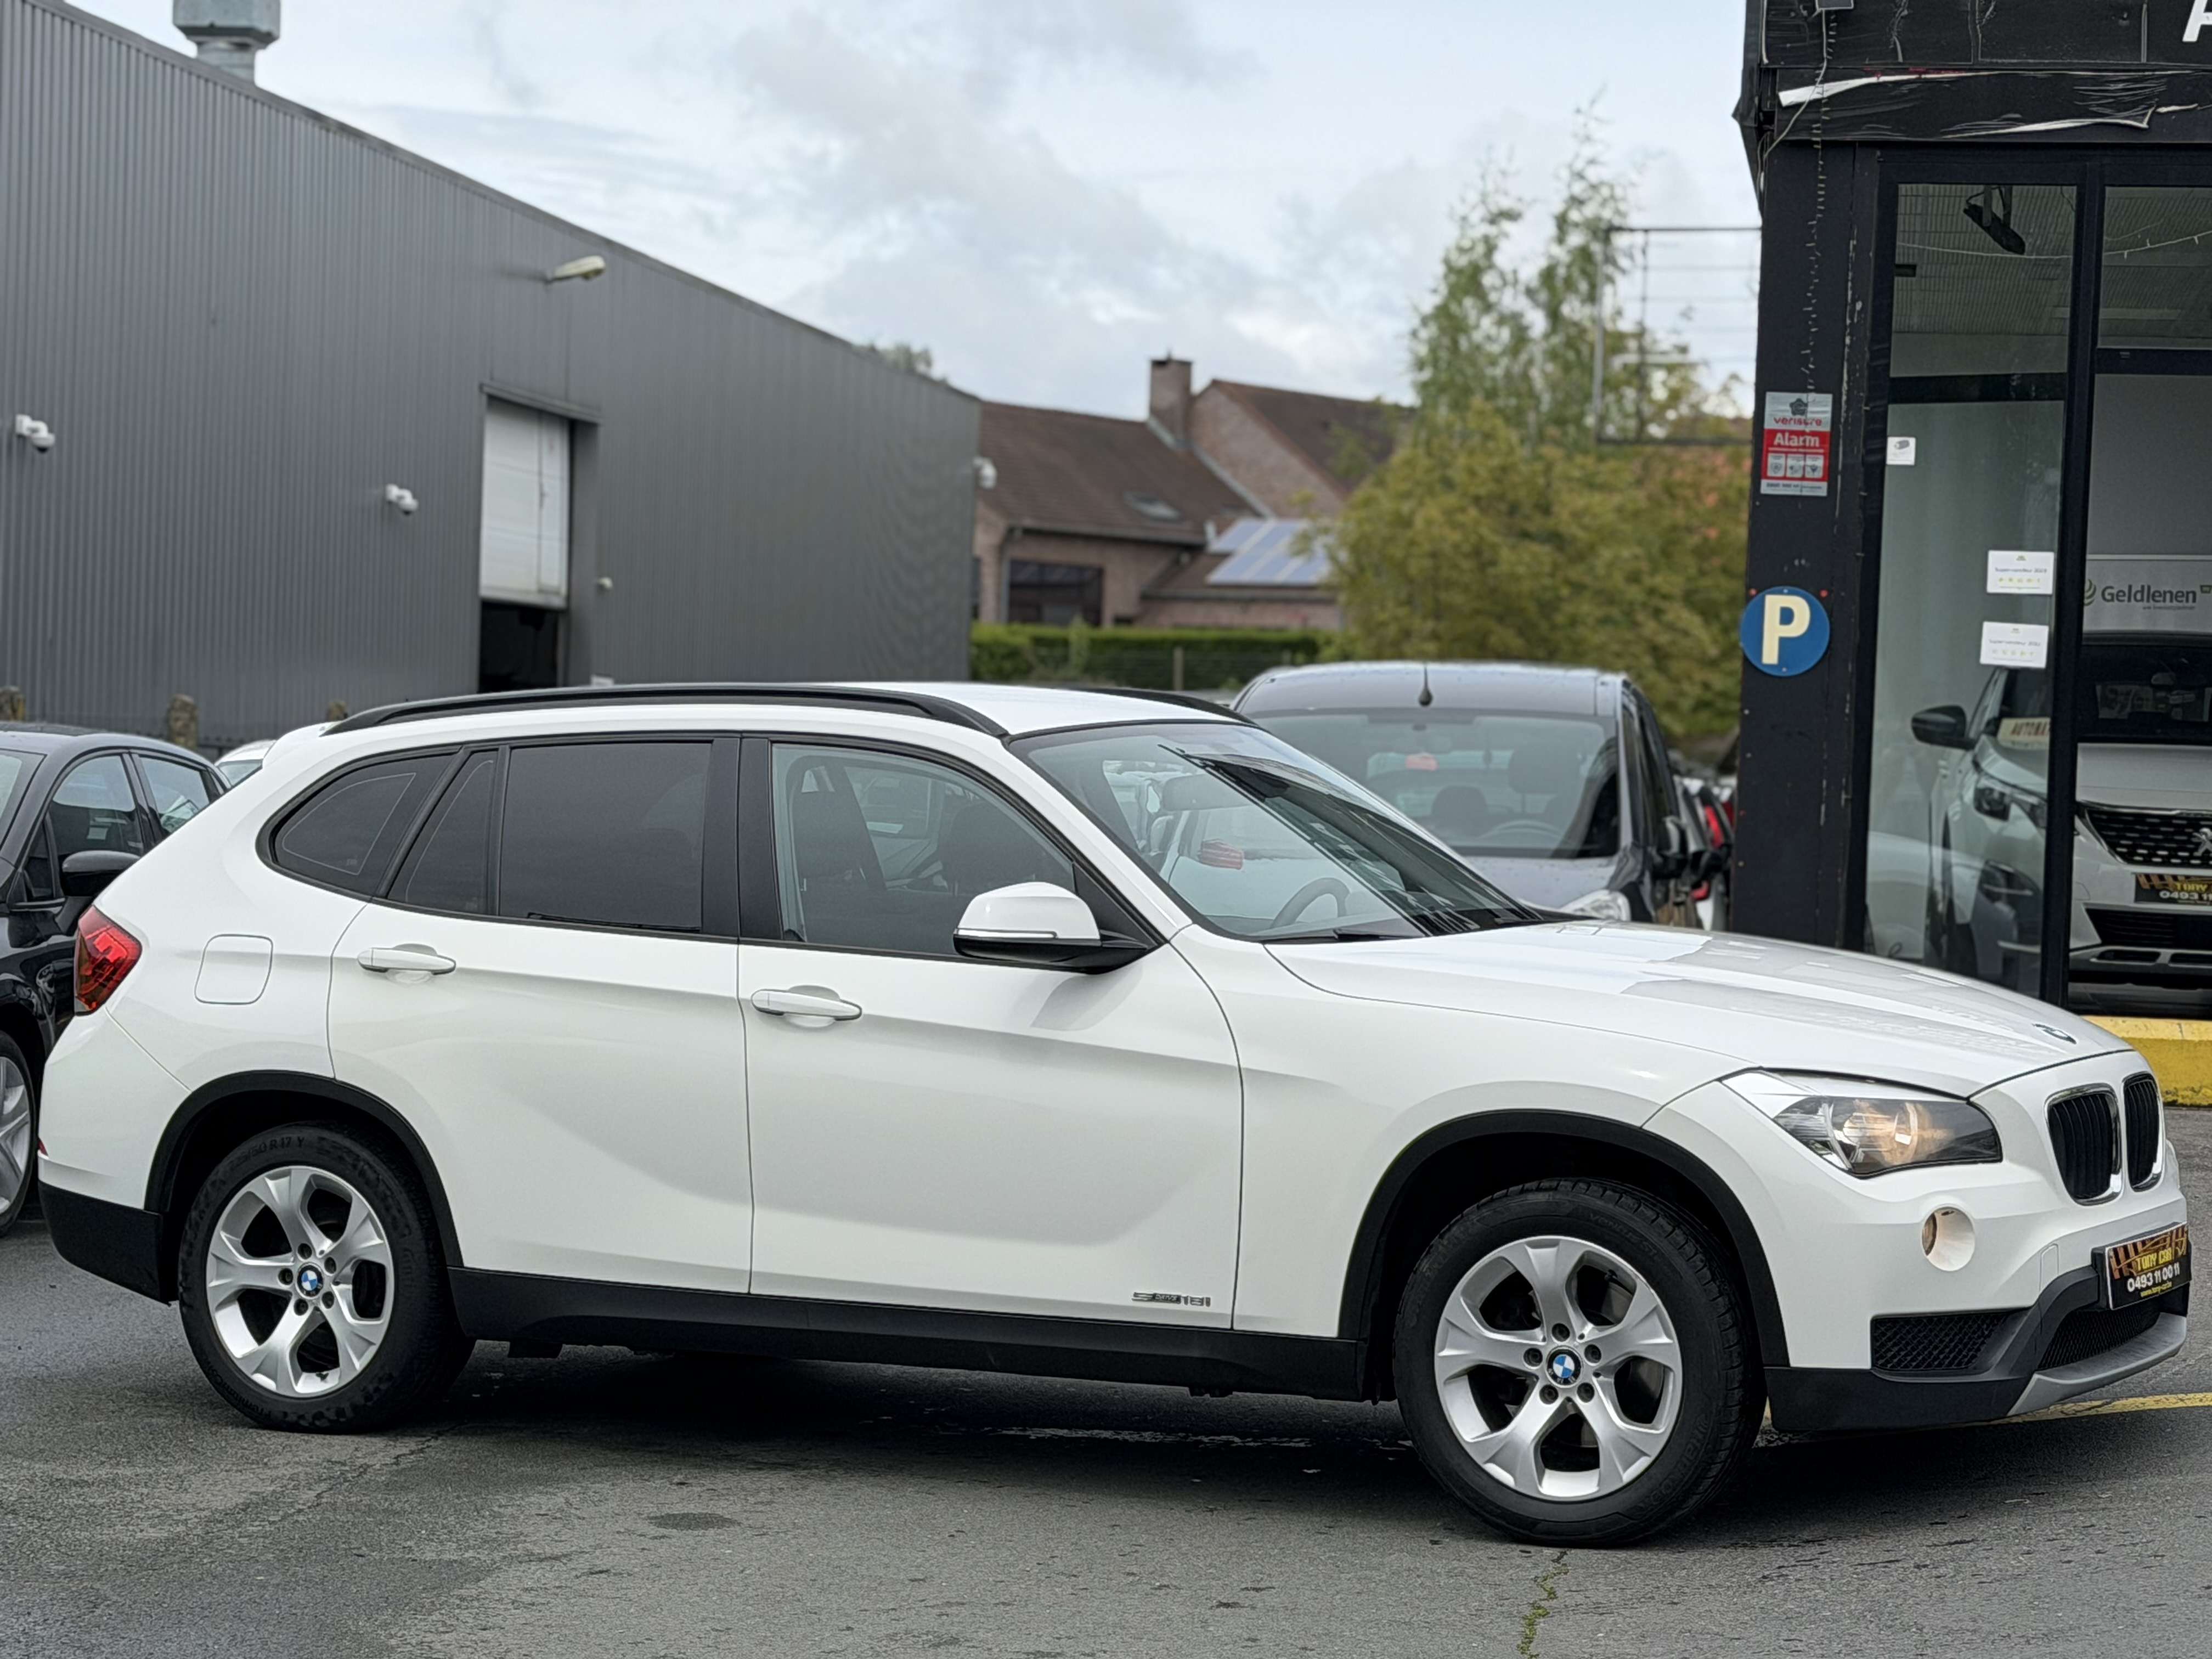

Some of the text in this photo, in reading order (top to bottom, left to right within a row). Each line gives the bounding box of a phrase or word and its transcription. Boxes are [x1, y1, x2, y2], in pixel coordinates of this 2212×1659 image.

[1773, 416, 1823, 426] verisure
[1773, 432, 1820, 448] Alarm
[2101, 584, 2197, 603] Geldlenen
[1762, 594, 1810, 665] P
[2159, 890, 2199, 900] 0493
[2136, 1252, 2157, 1271] TONY
[2127, 1261, 2180, 1293] 0493 11 00 11
